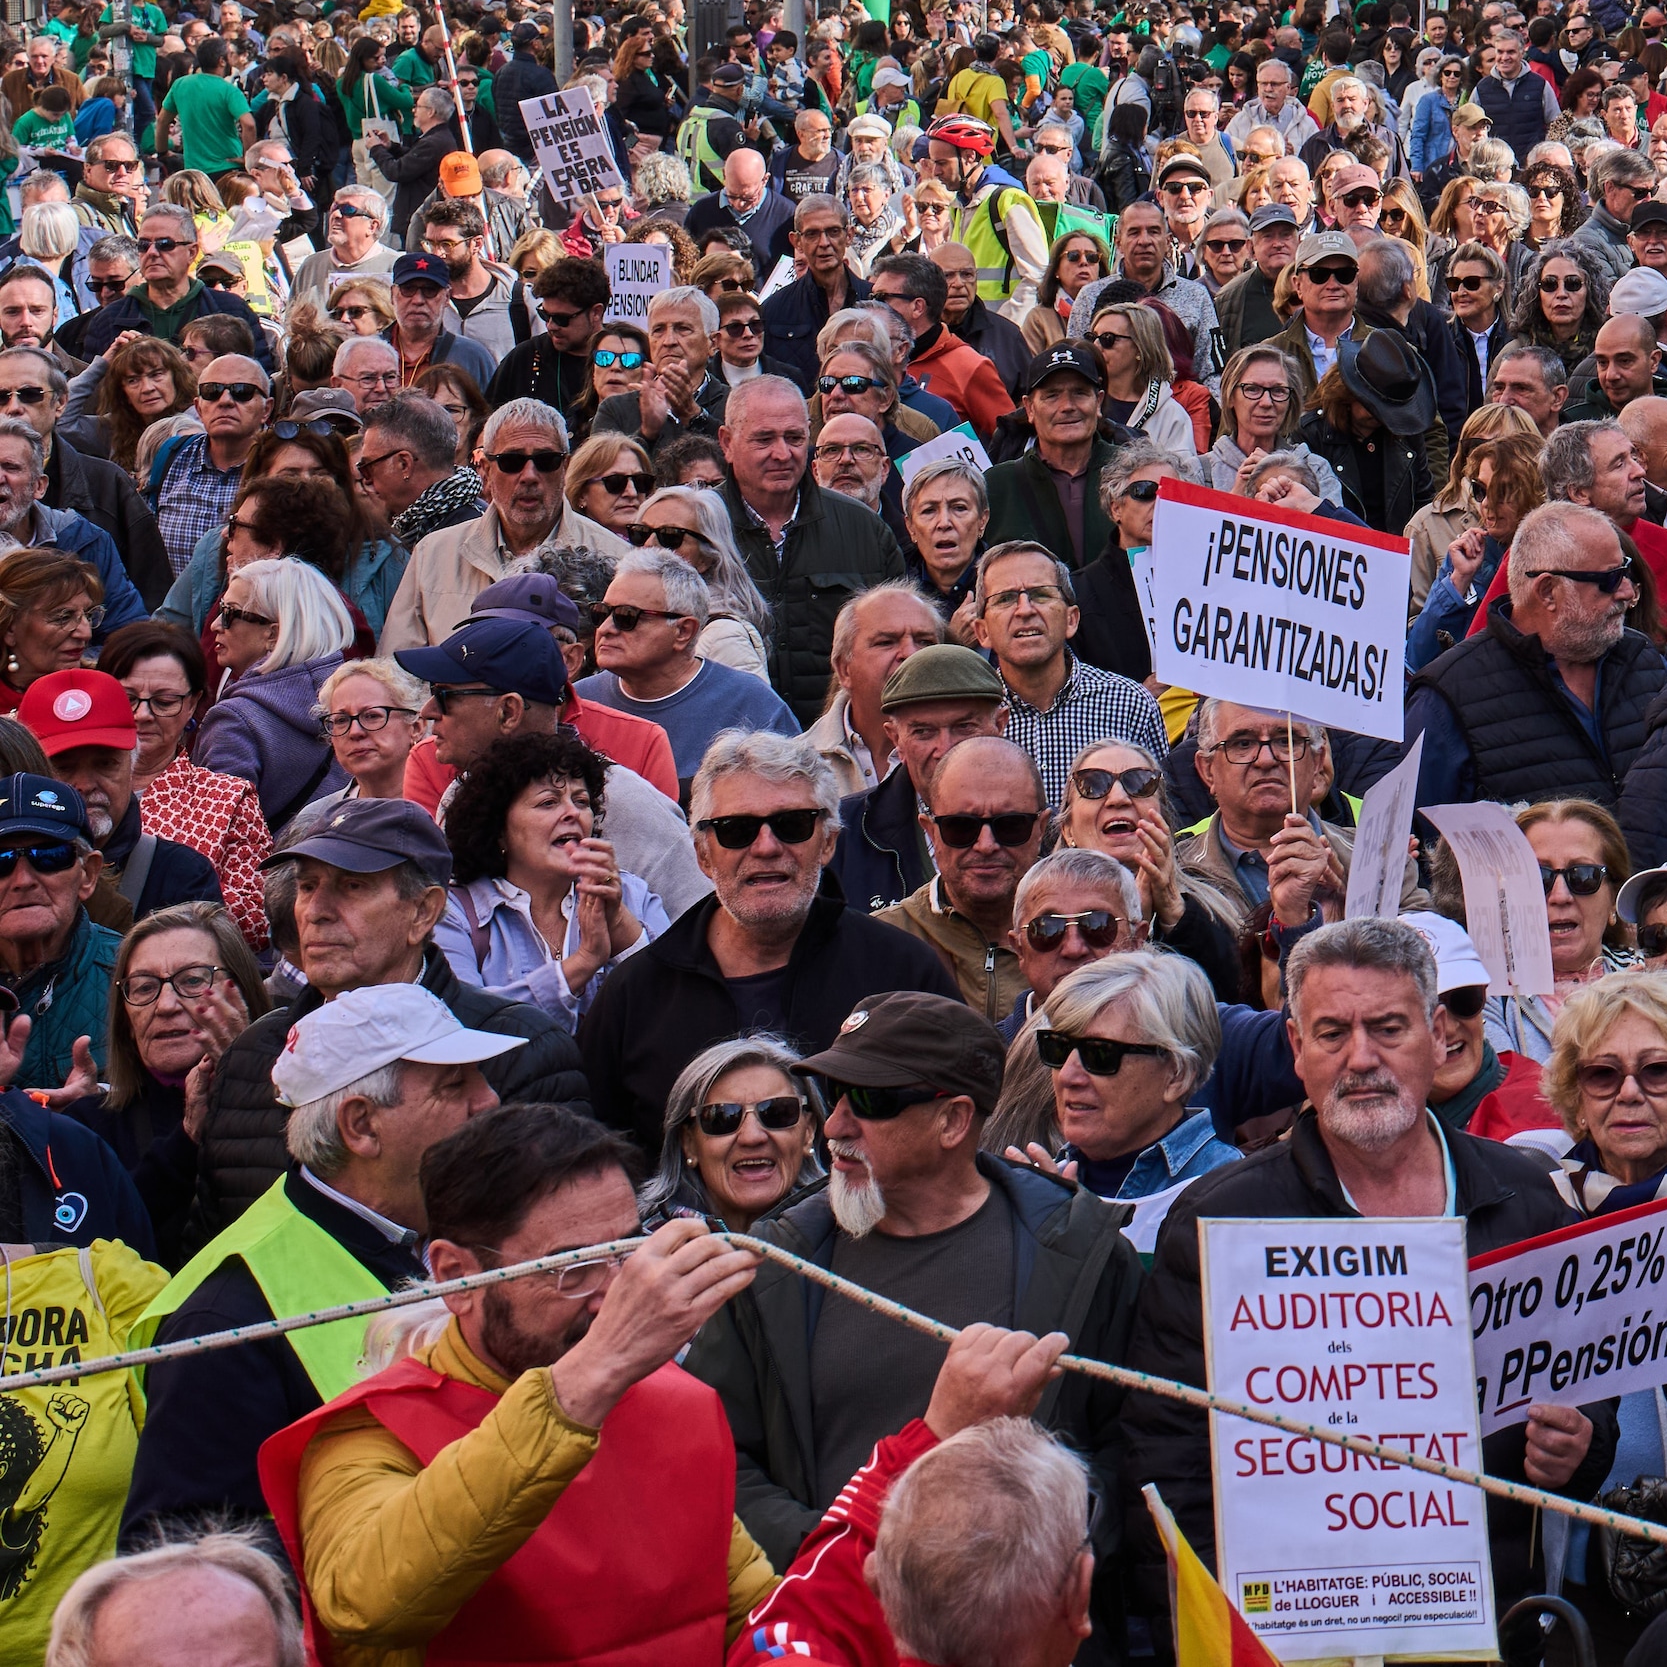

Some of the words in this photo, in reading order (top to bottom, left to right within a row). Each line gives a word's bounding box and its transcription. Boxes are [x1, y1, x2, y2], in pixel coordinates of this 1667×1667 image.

[558, 141, 583, 164] ES
[619, 259, 659, 284] BLINDAR
[1203, 518, 1369, 611] ¡PENSIONES
[1173, 599, 1385, 703] GARANTIZADAS!
[31, 801, 66, 811] superego
[1265, 1246, 1408, 1277] EXIGIM
[1230, 1292, 1453, 1332] AUDITORIA
[1328, 1340, 1352, 1355] dels
[1245, 1363, 1438, 1404] COMPTES
[1328, 1411, 1343, 1425] de
[1346, 1411, 1358, 1425] la
[1235, 1433, 1468, 1477] SEGURETAT
[1325, 1490, 1470, 1532] SOCIAL
[1372, 1573, 1425, 1590] PÚBLIC,
[1427, 1572, 1476, 1586] SOCIAL
[1274, 1597, 1292, 1612] de
[1294, 1596, 1360, 1611] LLOGUER
[1371, 1593, 1376, 1606] i
[1388, 1590, 1466, 1606] ACCESSIBLE
[1403, 1613, 1421, 1624] prou
